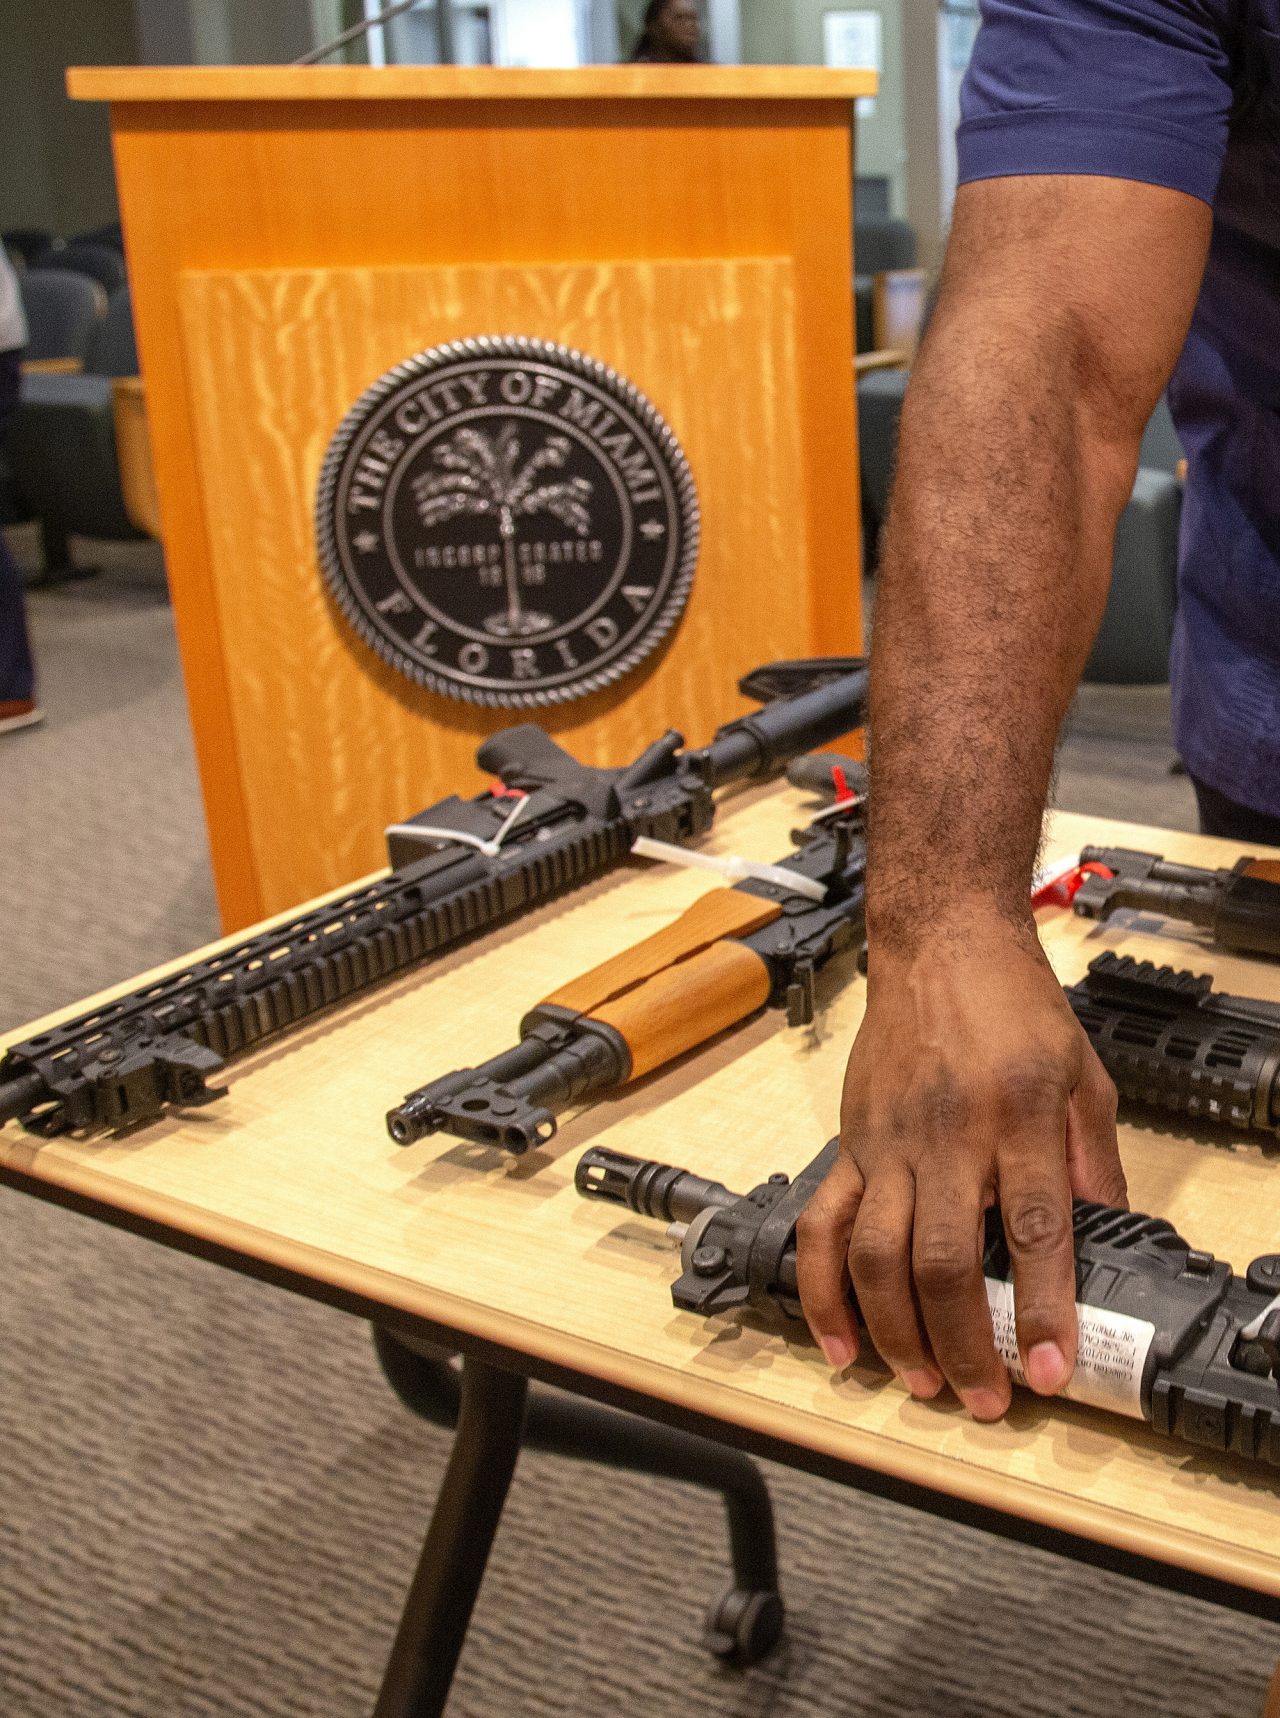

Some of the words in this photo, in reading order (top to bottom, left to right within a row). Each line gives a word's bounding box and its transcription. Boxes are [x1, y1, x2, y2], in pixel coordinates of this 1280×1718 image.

[350, 429, 406, 511] THE
[395, 373, 490, 434] CITY
[500, 371, 562, 407] OF
[559, 388, 660, 501] MIAMI
[375, 585, 654, 679] FLORIDA
